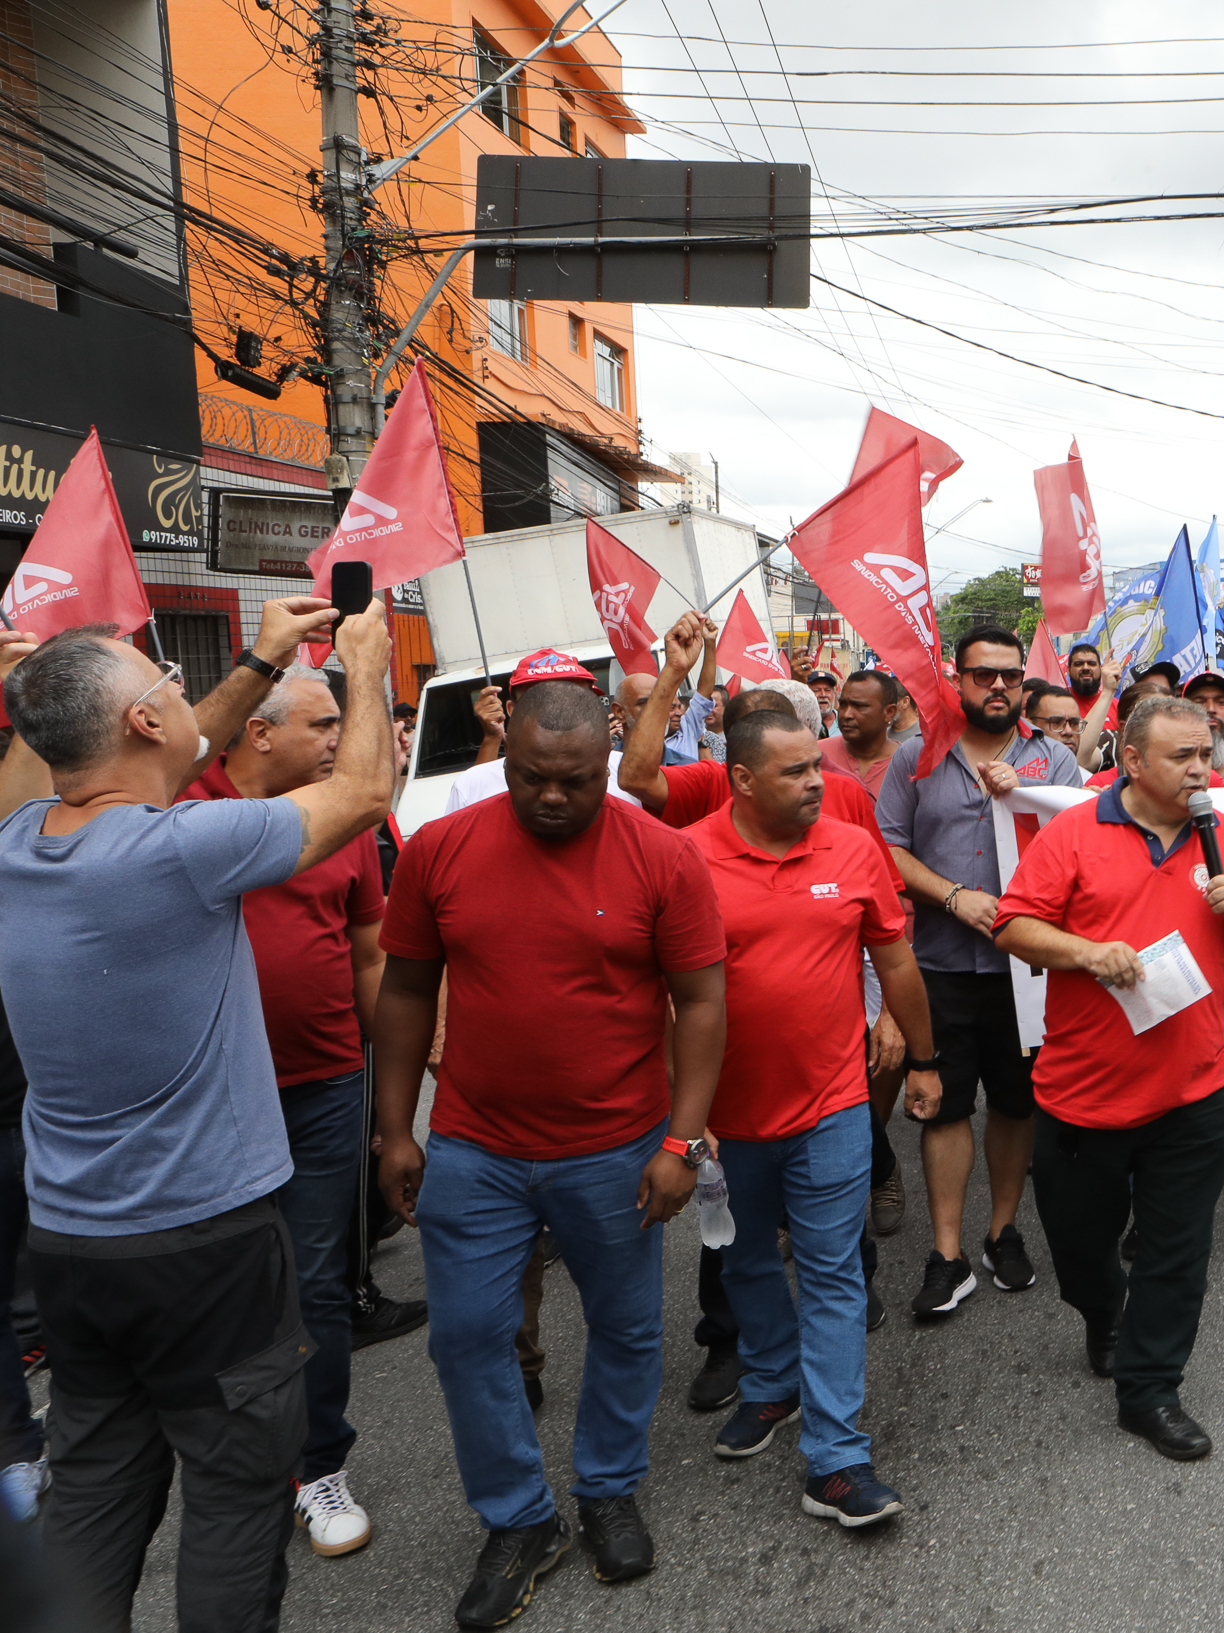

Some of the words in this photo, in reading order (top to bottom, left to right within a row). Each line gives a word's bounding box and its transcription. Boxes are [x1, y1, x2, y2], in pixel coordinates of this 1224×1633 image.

[150, 531, 199, 547] 91775-9519
[226, 518, 293, 538] CLÍNICA
[298, 524, 332, 540] GER
[851, 559, 897, 602] SINDICATO
